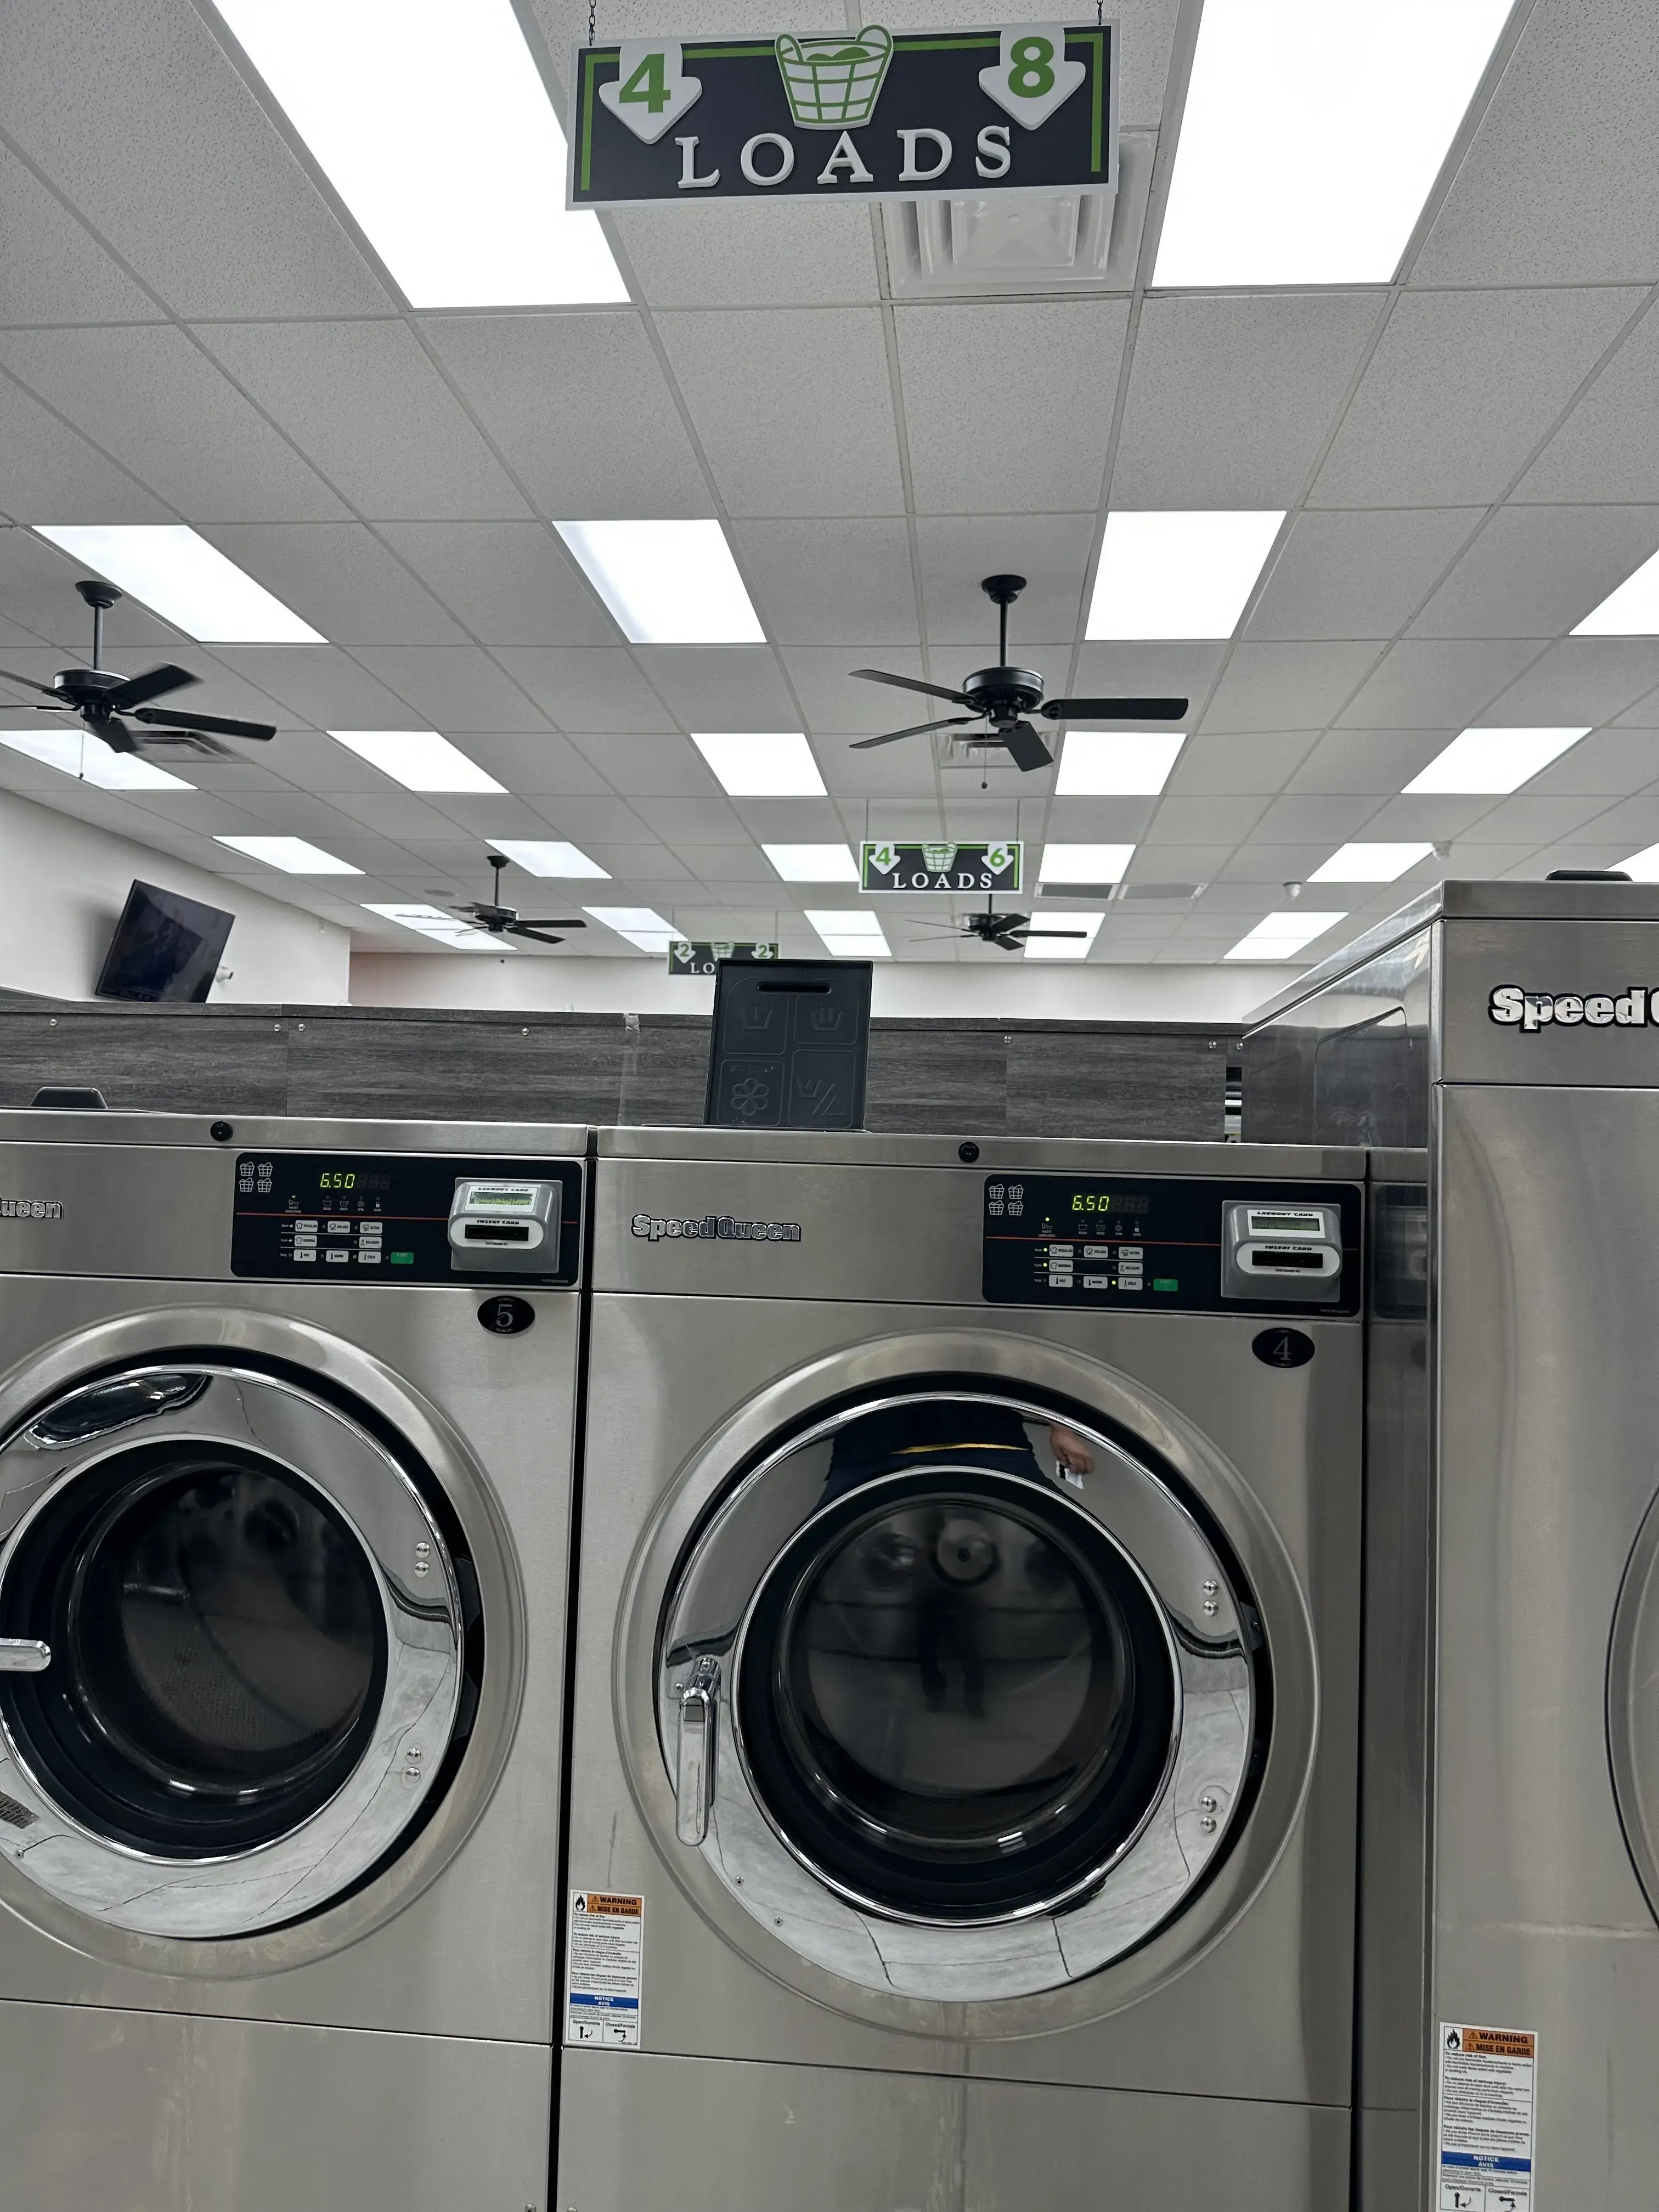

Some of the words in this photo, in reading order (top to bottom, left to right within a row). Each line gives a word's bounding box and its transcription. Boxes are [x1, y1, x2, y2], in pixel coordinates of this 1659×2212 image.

[1007, 36, 1055, 98] 8
[618, 53, 670, 113] 4
[674, 126, 1011, 189] LOADS
[876, 847, 891, 865] 4
[990, 848, 1005, 867] 6
[892, 872, 992, 889] LOADS
[680, 944, 689, 957] 2
[758, 945, 768, 958] 2
[1488, 984, 1648, 1033] Speed
[320, 1173, 356, 1188] 6.50
[0, 1197, 63, 1219] ueen
[1072, 1195, 1109, 1211] 6.50
[631, 1214, 716, 1242] Speed
[716, 1215, 802, 1242] Queen
[496, 1304, 514, 1327] 5
[1273, 1336, 1293, 1361] 4
[600, 1896, 637, 1905] WARNING
[1479, 2032, 1528, 2044] WARNING
[1476, 2043, 1493, 2052] MISE
[1506, 2047, 1531, 2055] GARDE
